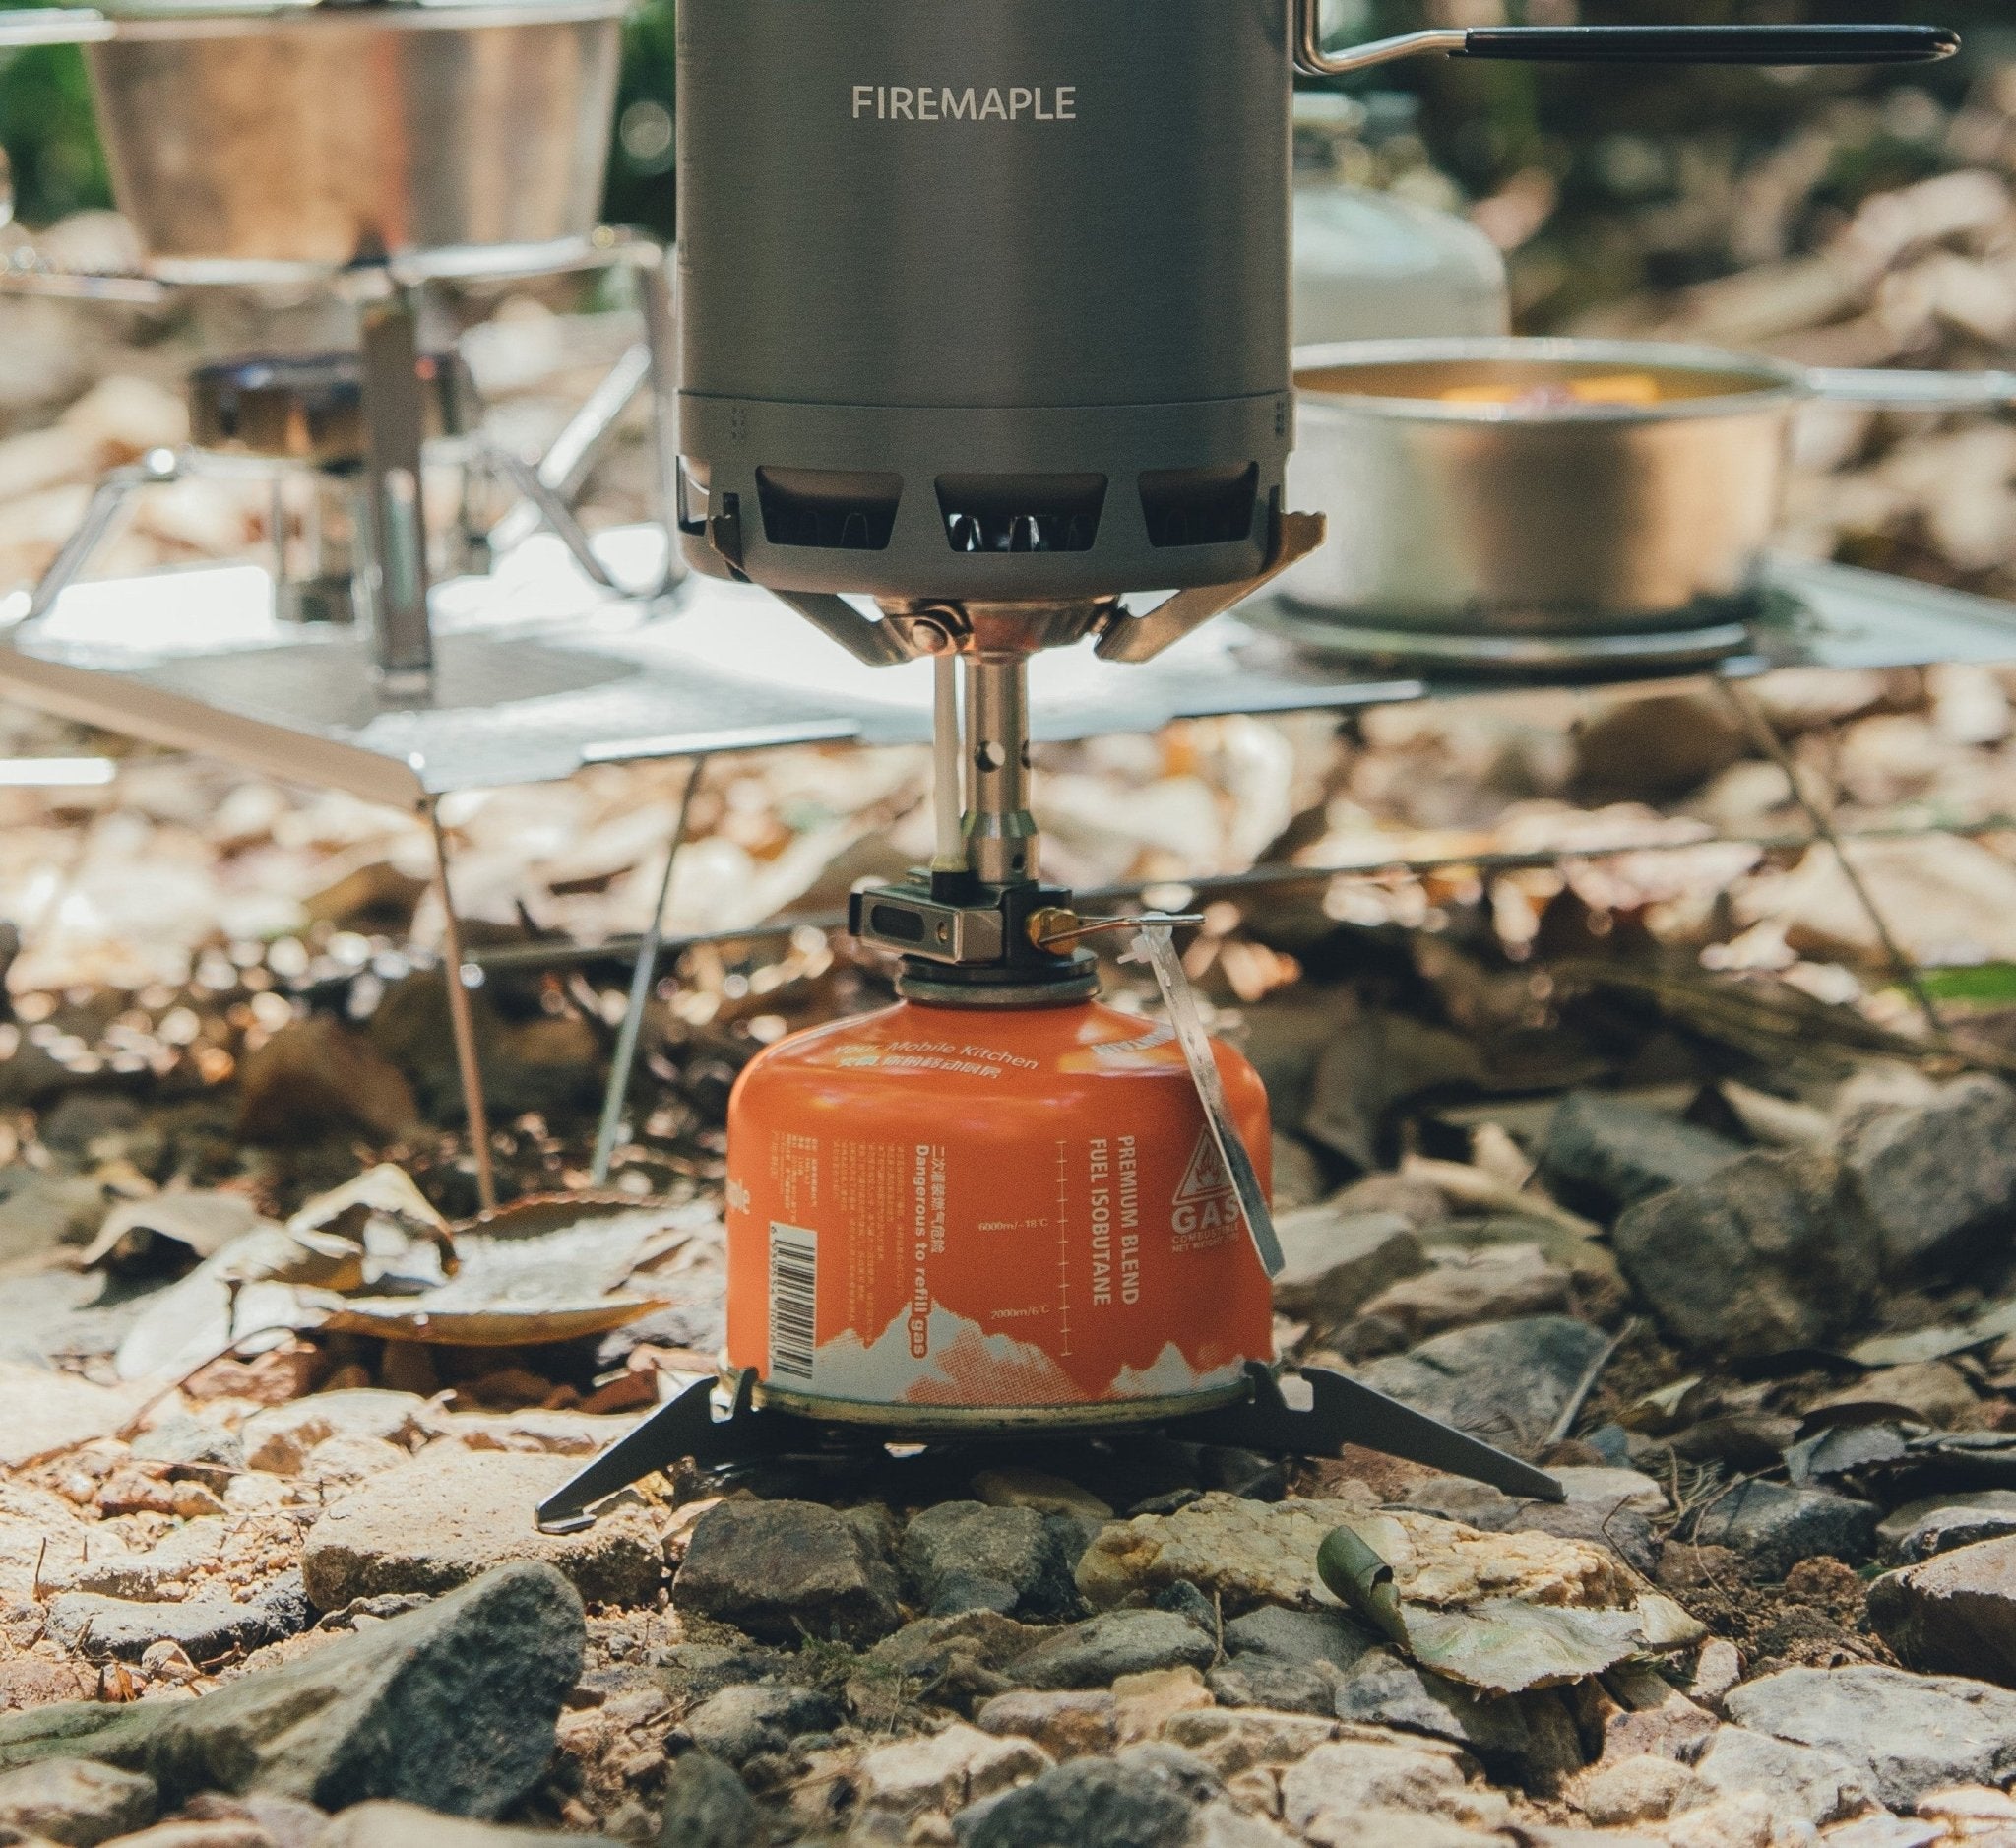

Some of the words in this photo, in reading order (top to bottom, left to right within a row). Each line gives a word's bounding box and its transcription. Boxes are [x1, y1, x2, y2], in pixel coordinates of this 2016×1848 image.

[852, 85, 1077, 121] FIREMAPLE
[886, 1041, 956, 1055] Mobile
[959, 1044, 1040, 1070] Kitchen
[1090, 1138, 1109, 1183] FUEL
[1118, 1135, 1139, 1229] PREMIUM
[913, 1144, 930, 1238] Dangerous
[1171, 1195, 1240, 1235] GAS
[915, 1243, 928, 1262] to
[1091, 1188, 1112, 1306] ISOBUTANE
[914, 1267, 929, 1313] refill
[1121, 1234, 1140, 1306] BLEND
[911, 1319, 927, 1356] gas
